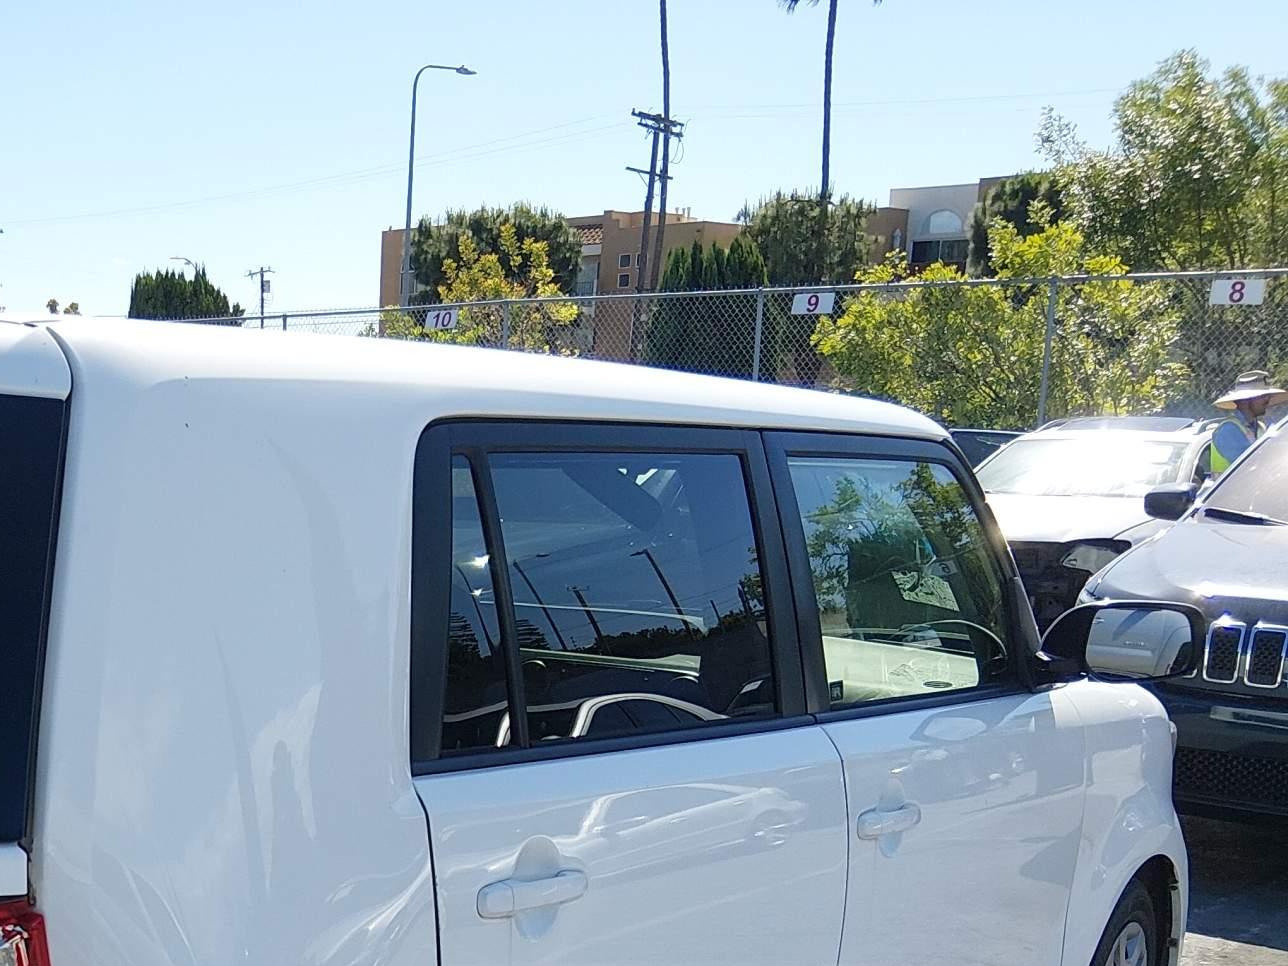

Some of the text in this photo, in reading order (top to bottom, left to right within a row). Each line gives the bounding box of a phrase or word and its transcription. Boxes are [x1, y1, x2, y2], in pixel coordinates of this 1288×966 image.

[1228, 280, 1246, 304] 8
[806, 294, 820, 313] 9
[432, 311, 452, 328] 10
